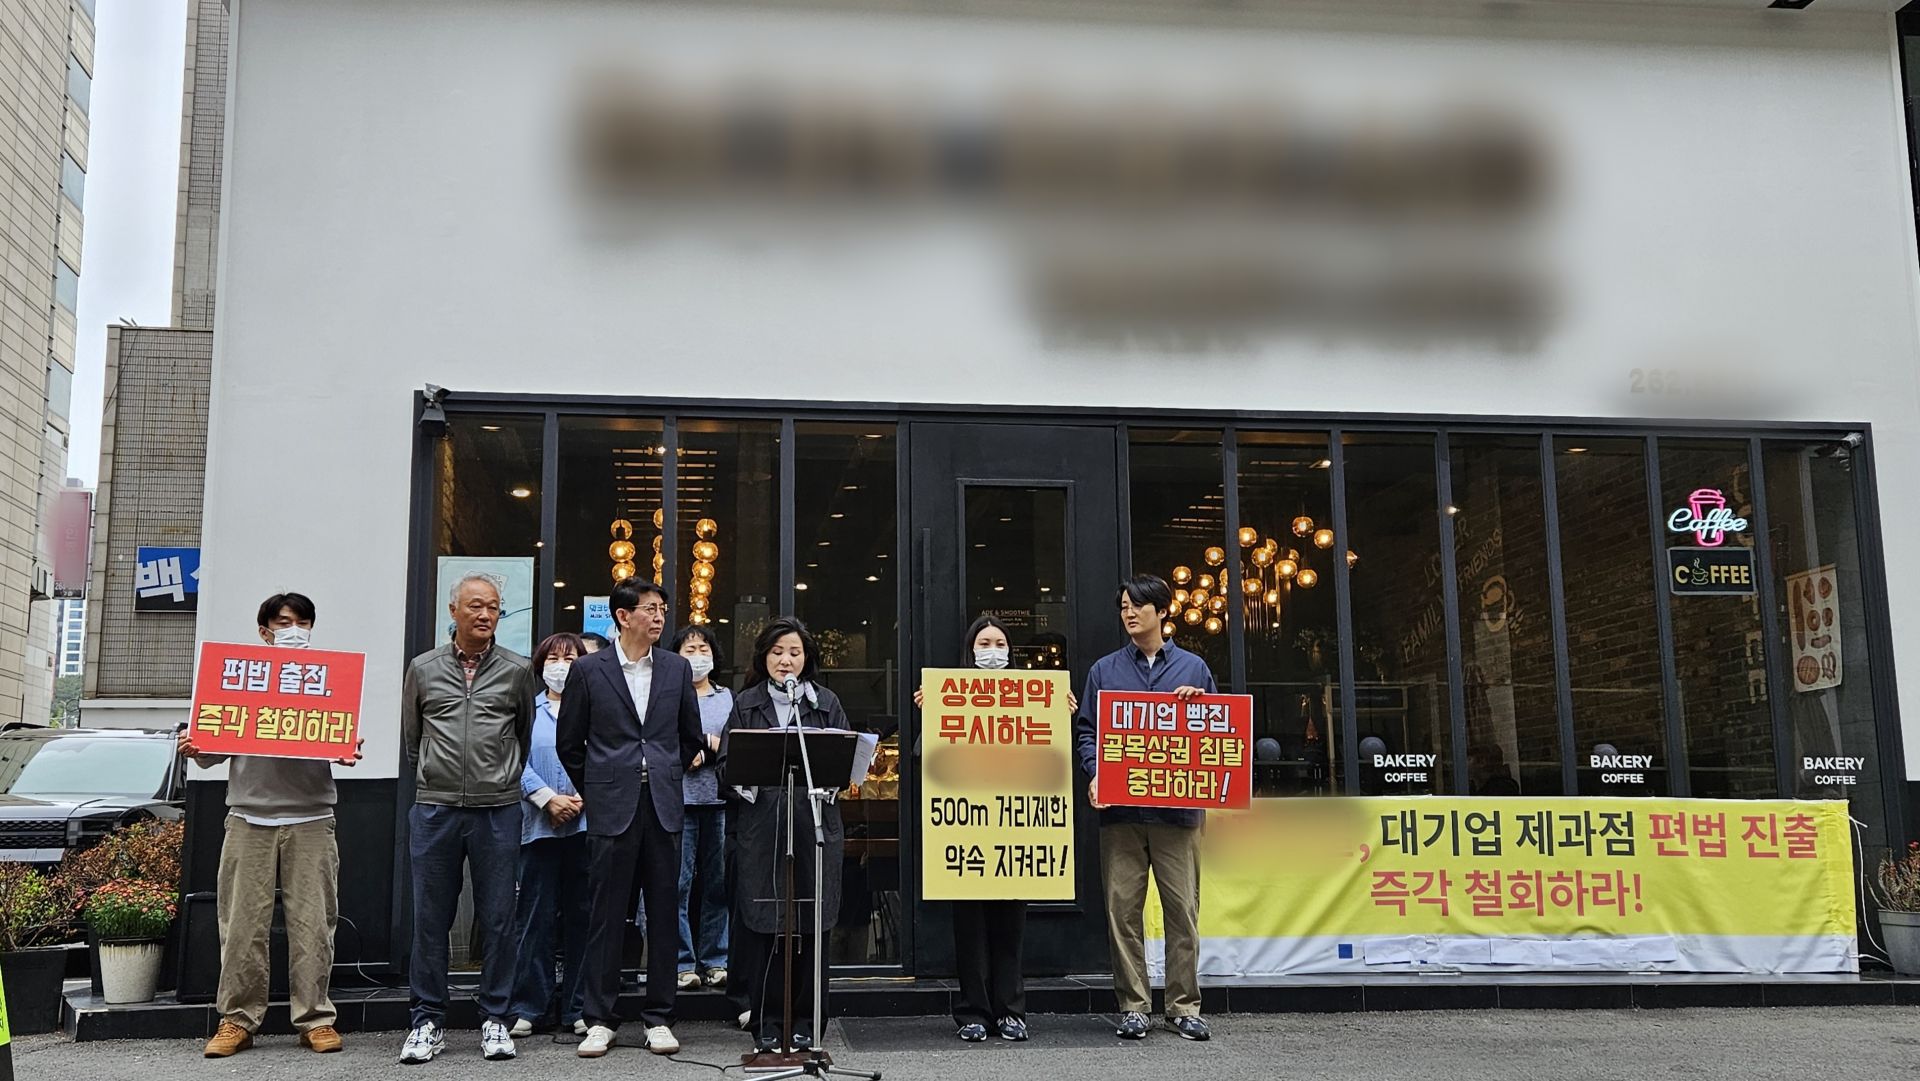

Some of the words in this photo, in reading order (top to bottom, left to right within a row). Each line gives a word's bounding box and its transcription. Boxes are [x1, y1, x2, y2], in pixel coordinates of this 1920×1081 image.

[1668, 508, 1748, 538] Coffee
[1457, 527, 1503, 593] FRIENDS
[221, 658, 271, 693] 편법
[940, 677, 1054, 709] 상생협약
[196, 704, 249, 738] 즉각
[256, 706, 354, 744] 철회하라
[939, 714, 1053, 746] 무시하는
[1111, 701, 1177, 733] 대기업
[1102, 733, 1190, 765] 골목상권
[1199, 735, 1245, 767] 침탈
[1373, 754, 1437, 769] BAKERY
[1590, 754, 1653, 769] BAKERY
[1803, 756, 1865, 771] BAKERY
[1127, 768, 1231, 804] 중단하라!
[1384, 773, 1428, 783] COFFEE
[1601, 773, 1645, 784] COFFEE
[1814, 775, 1857, 785] COFFEE
[930, 797, 989, 827] 500m
[995, 795, 1068, 828] 거리제한
[1380, 810, 1502, 857] 대기업
[1515, 810, 1635, 857] 제과점
[1649, 811, 1728, 858] 편법
[1742, 813, 1819, 859] 진출
[945, 844, 986, 877] 약속
[994, 844, 1069, 877] 지켜라!
[1370, 870, 1453, 916] 즉각
[1465, 869, 1643, 917] 철회하라!
